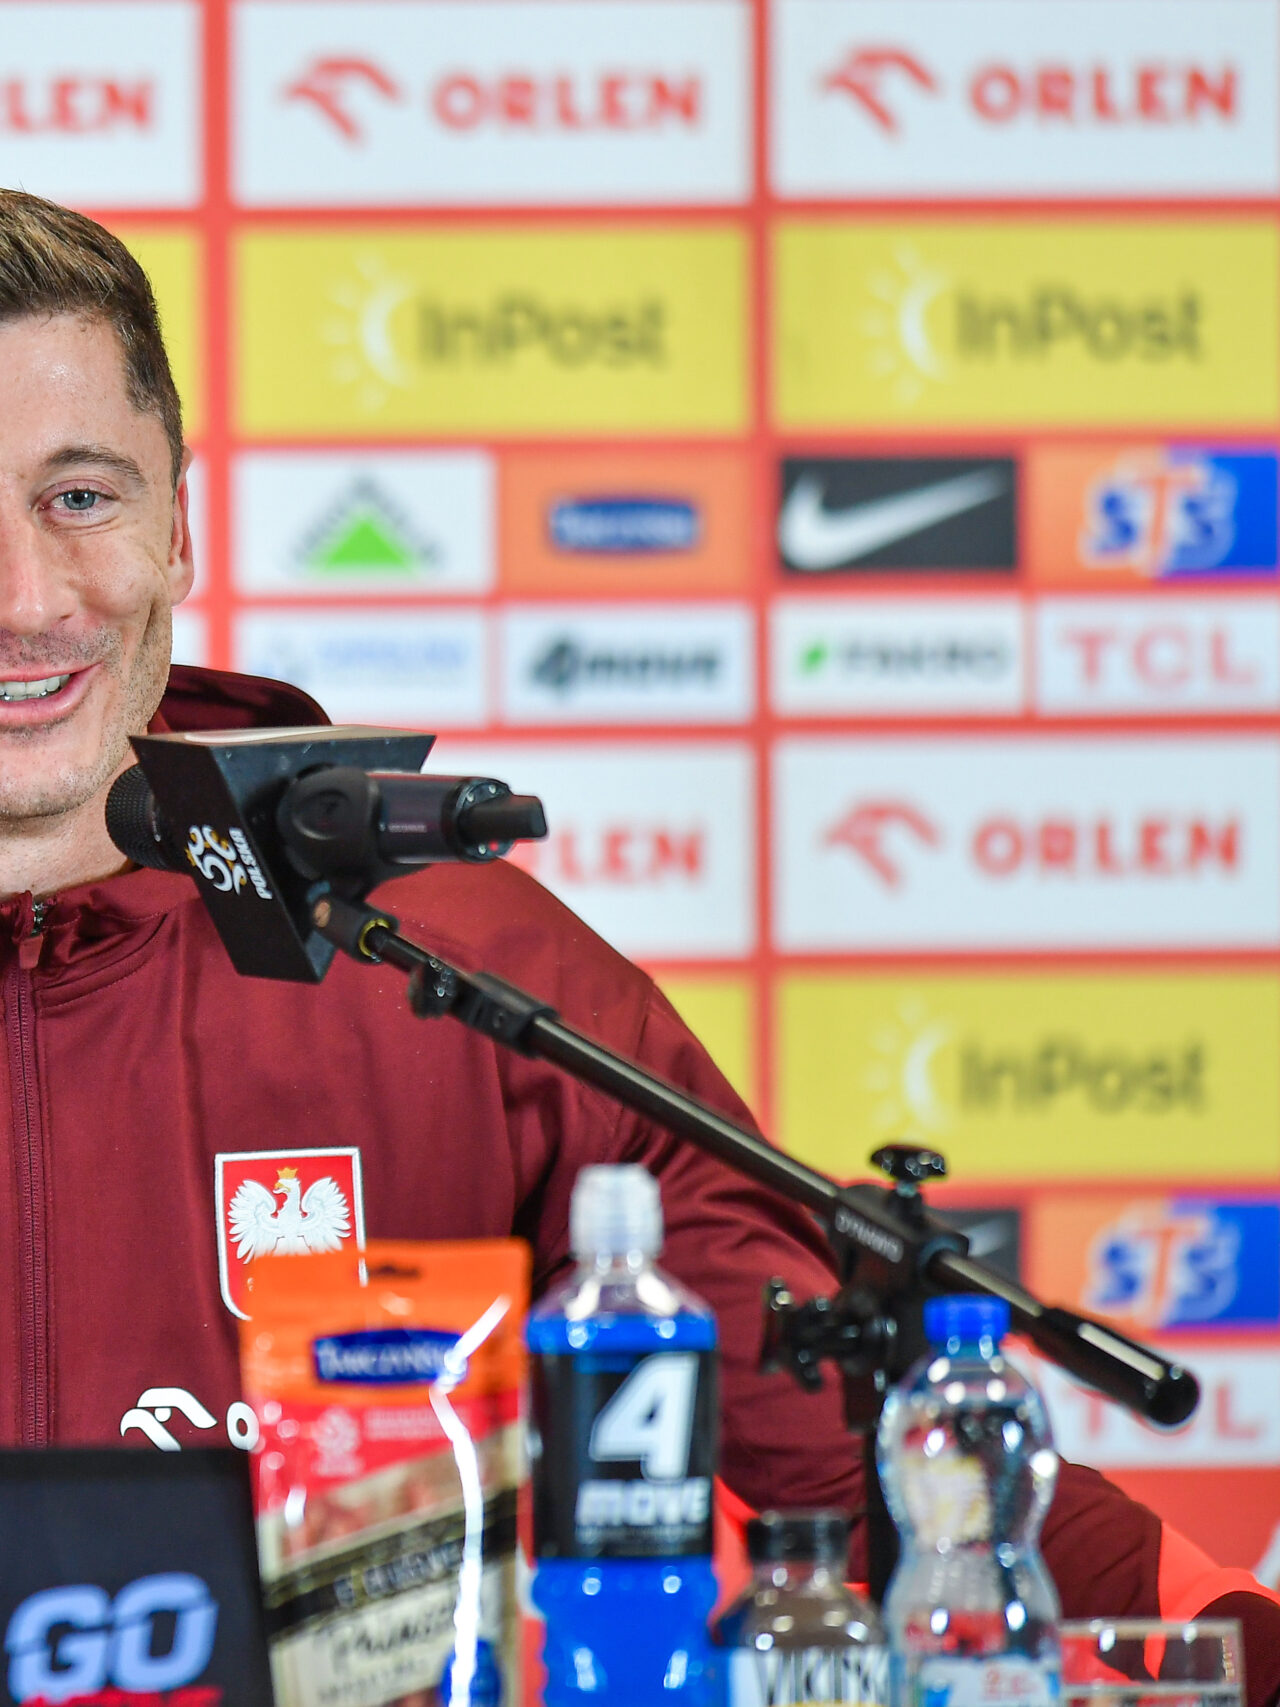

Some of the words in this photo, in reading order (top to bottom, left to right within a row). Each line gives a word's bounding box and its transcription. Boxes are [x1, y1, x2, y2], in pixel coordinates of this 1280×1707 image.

[431, 72, 702, 131] ORLEN
[968, 64, 1237, 123] ORLEN
[417, 290, 667, 368] InPost
[955, 283, 1204, 362] InPost
[1080, 448, 1238, 578] STS
[1063, 624, 1258, 691] TCL
[229, 826, 273, 900] POLSKA
[558, 827, 704, 883] LEN
[971, 817, 1241, 876] ORLEN
[960, 1036, 1208, 1114] InPost
[1083, 1203, 1240, 1326] STS
[590, 1350, 700, 1483] 4
[1065, 1382, 1261, 1440] TL
[5, 1572, 218, 1703] GO
